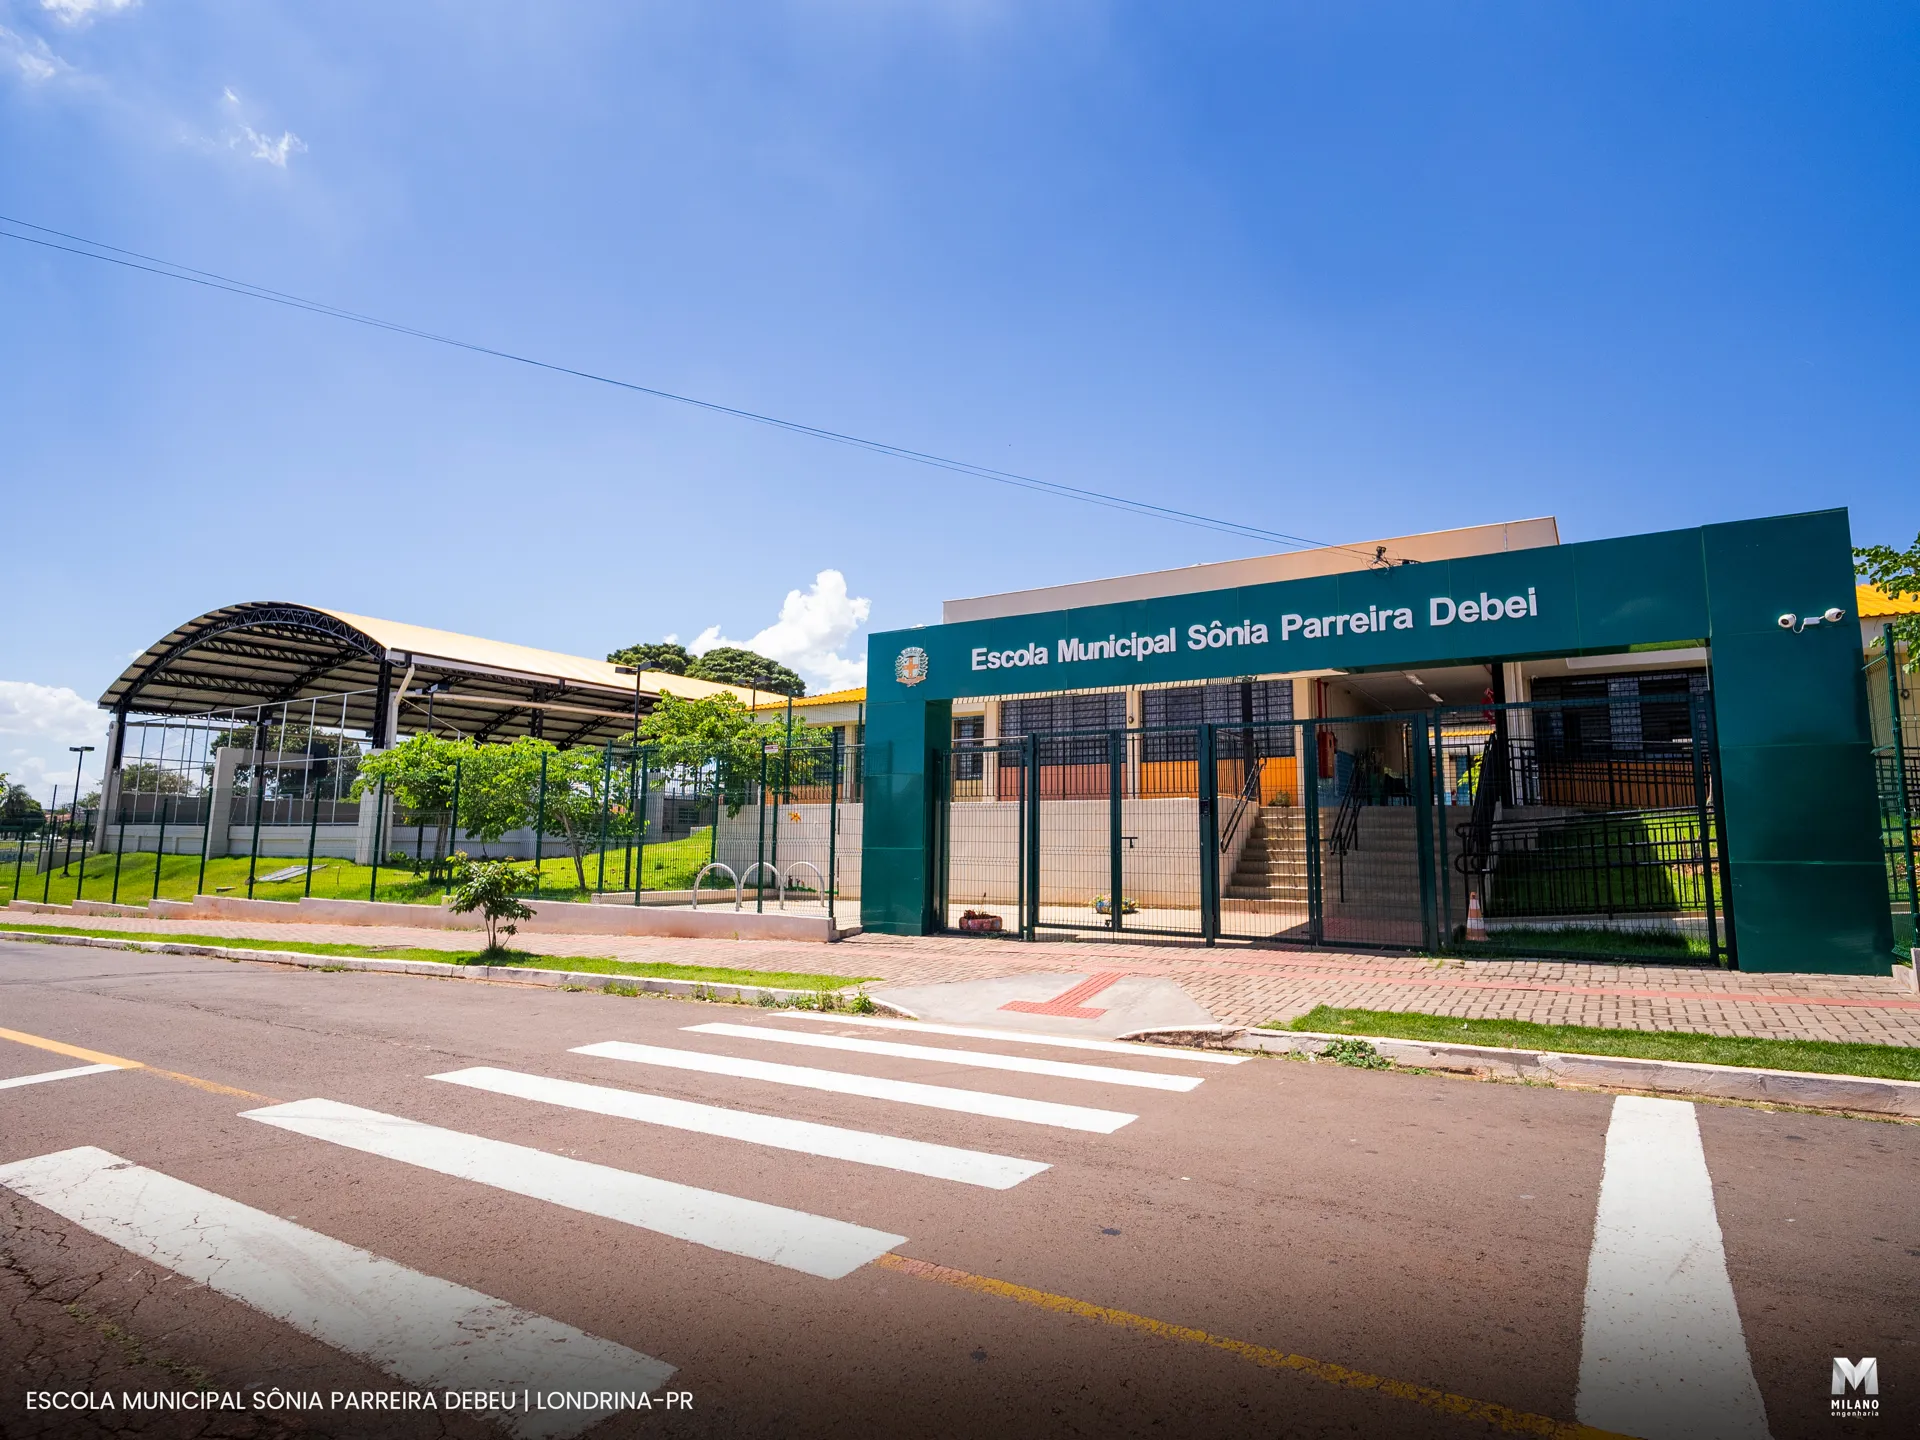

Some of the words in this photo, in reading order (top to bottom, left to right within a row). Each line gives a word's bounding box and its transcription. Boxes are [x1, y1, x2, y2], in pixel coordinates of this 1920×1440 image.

[970, 641, 1049, 671] Escola
[1057, 627, 1177, 663] Municipal
[1187, 621, 1269, 651] Sônia
[1282, 605, 1414, 641] Parreira
[1430, 587, 1538, 627] Debei
